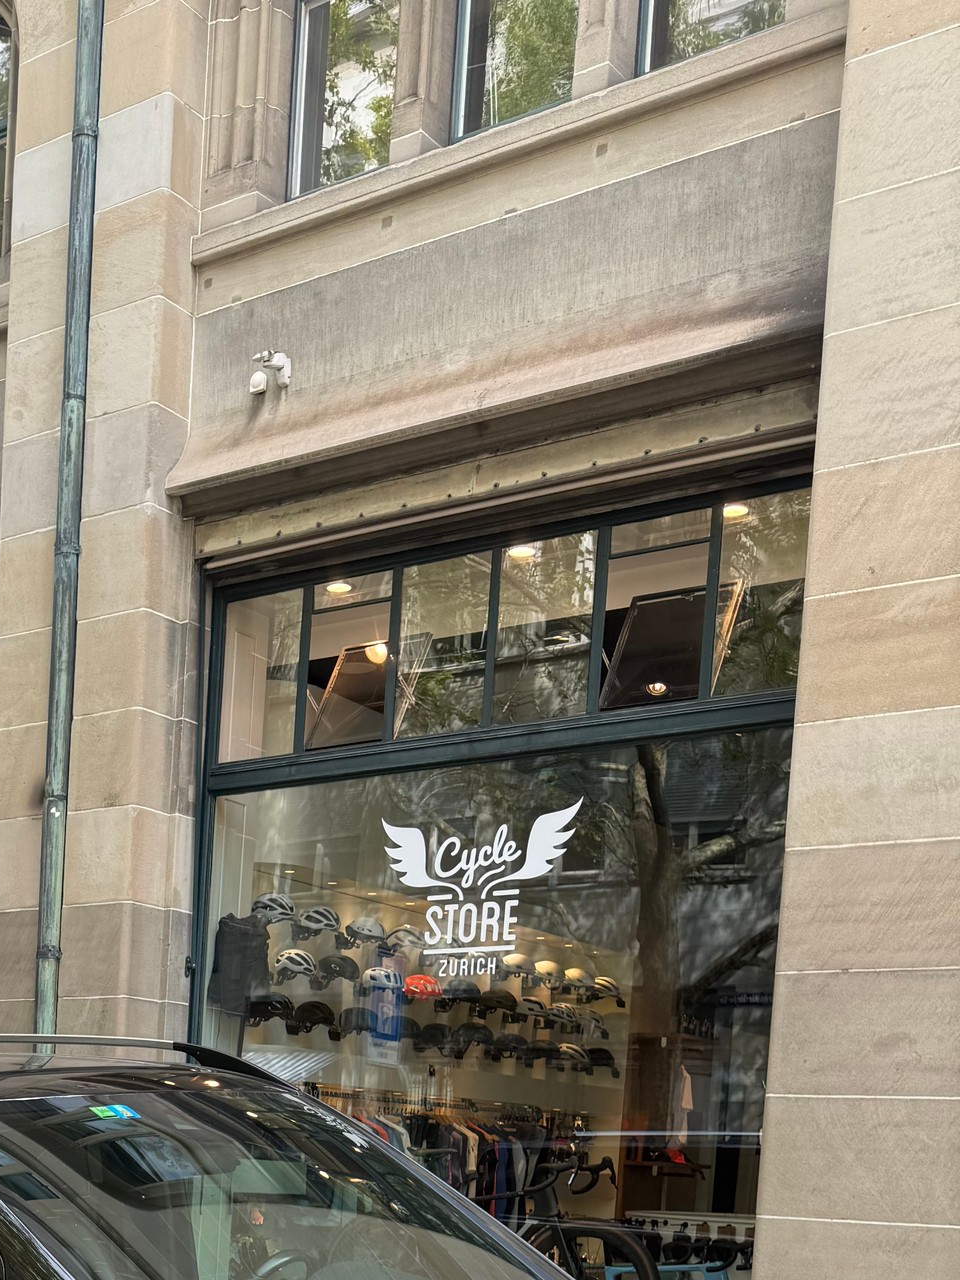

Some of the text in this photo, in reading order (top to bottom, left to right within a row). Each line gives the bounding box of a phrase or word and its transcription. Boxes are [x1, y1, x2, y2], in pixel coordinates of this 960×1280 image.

[434, 824, 522, 888] Cycle
[424, 900, 520, 945] STORE
[438, 956, 497, 977] ZURICH
